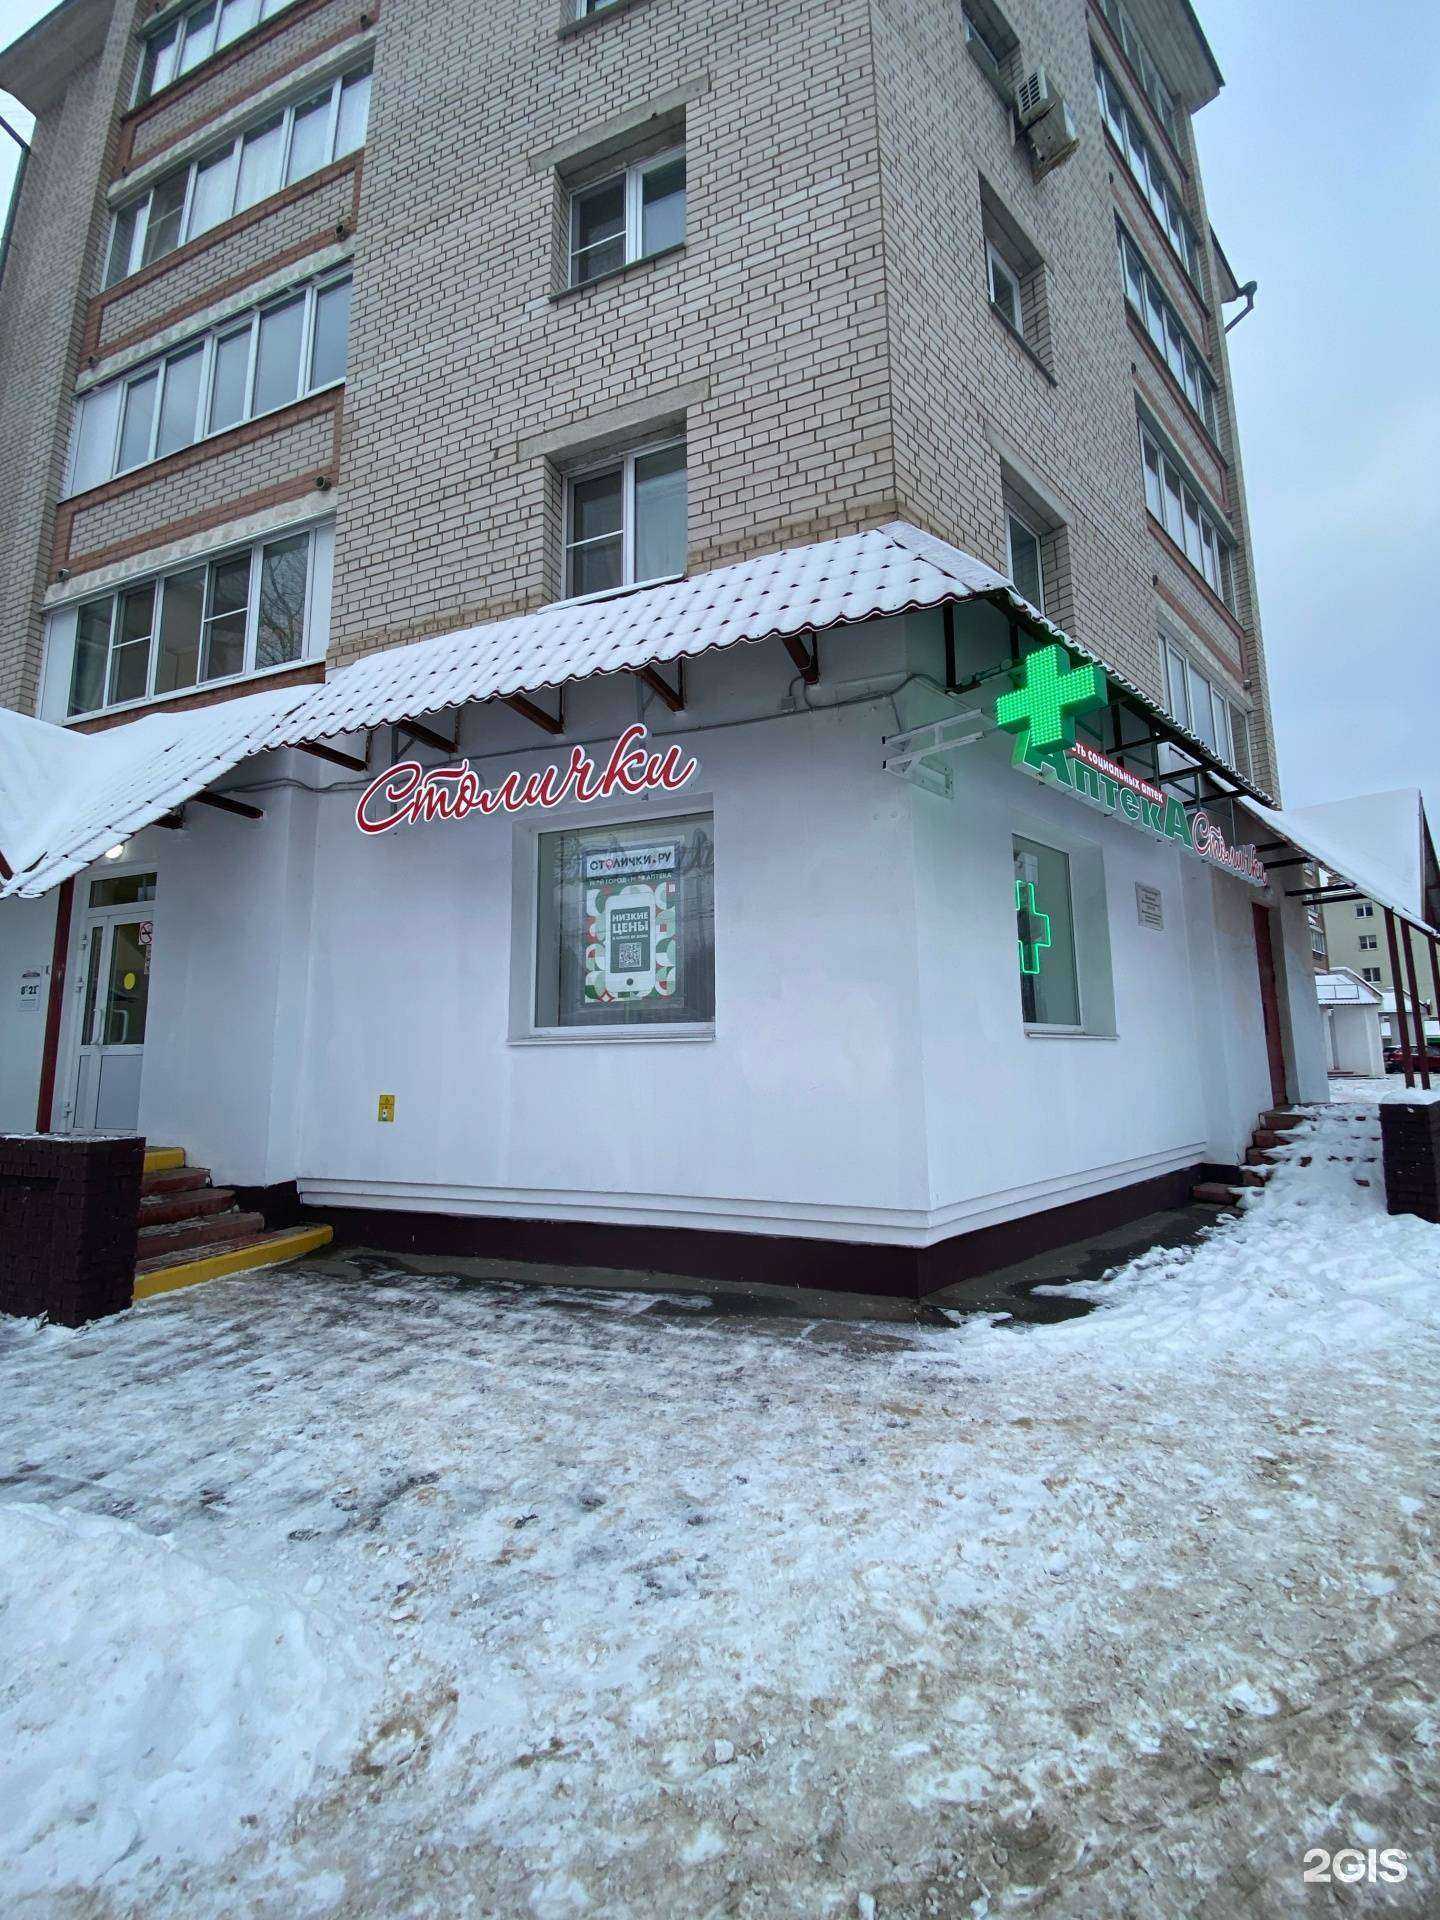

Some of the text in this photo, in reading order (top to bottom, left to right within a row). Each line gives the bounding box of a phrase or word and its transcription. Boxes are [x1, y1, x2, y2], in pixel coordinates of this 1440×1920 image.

[355, 723, 697, 835] Столички
[1087, 750, 1141, 791] социальных
[1140, 782, 1164, 804] аптек
[612, 911, 649, 922] НИЗКИЕ
[612, 921, 649, 935] ЦЕНЫ
